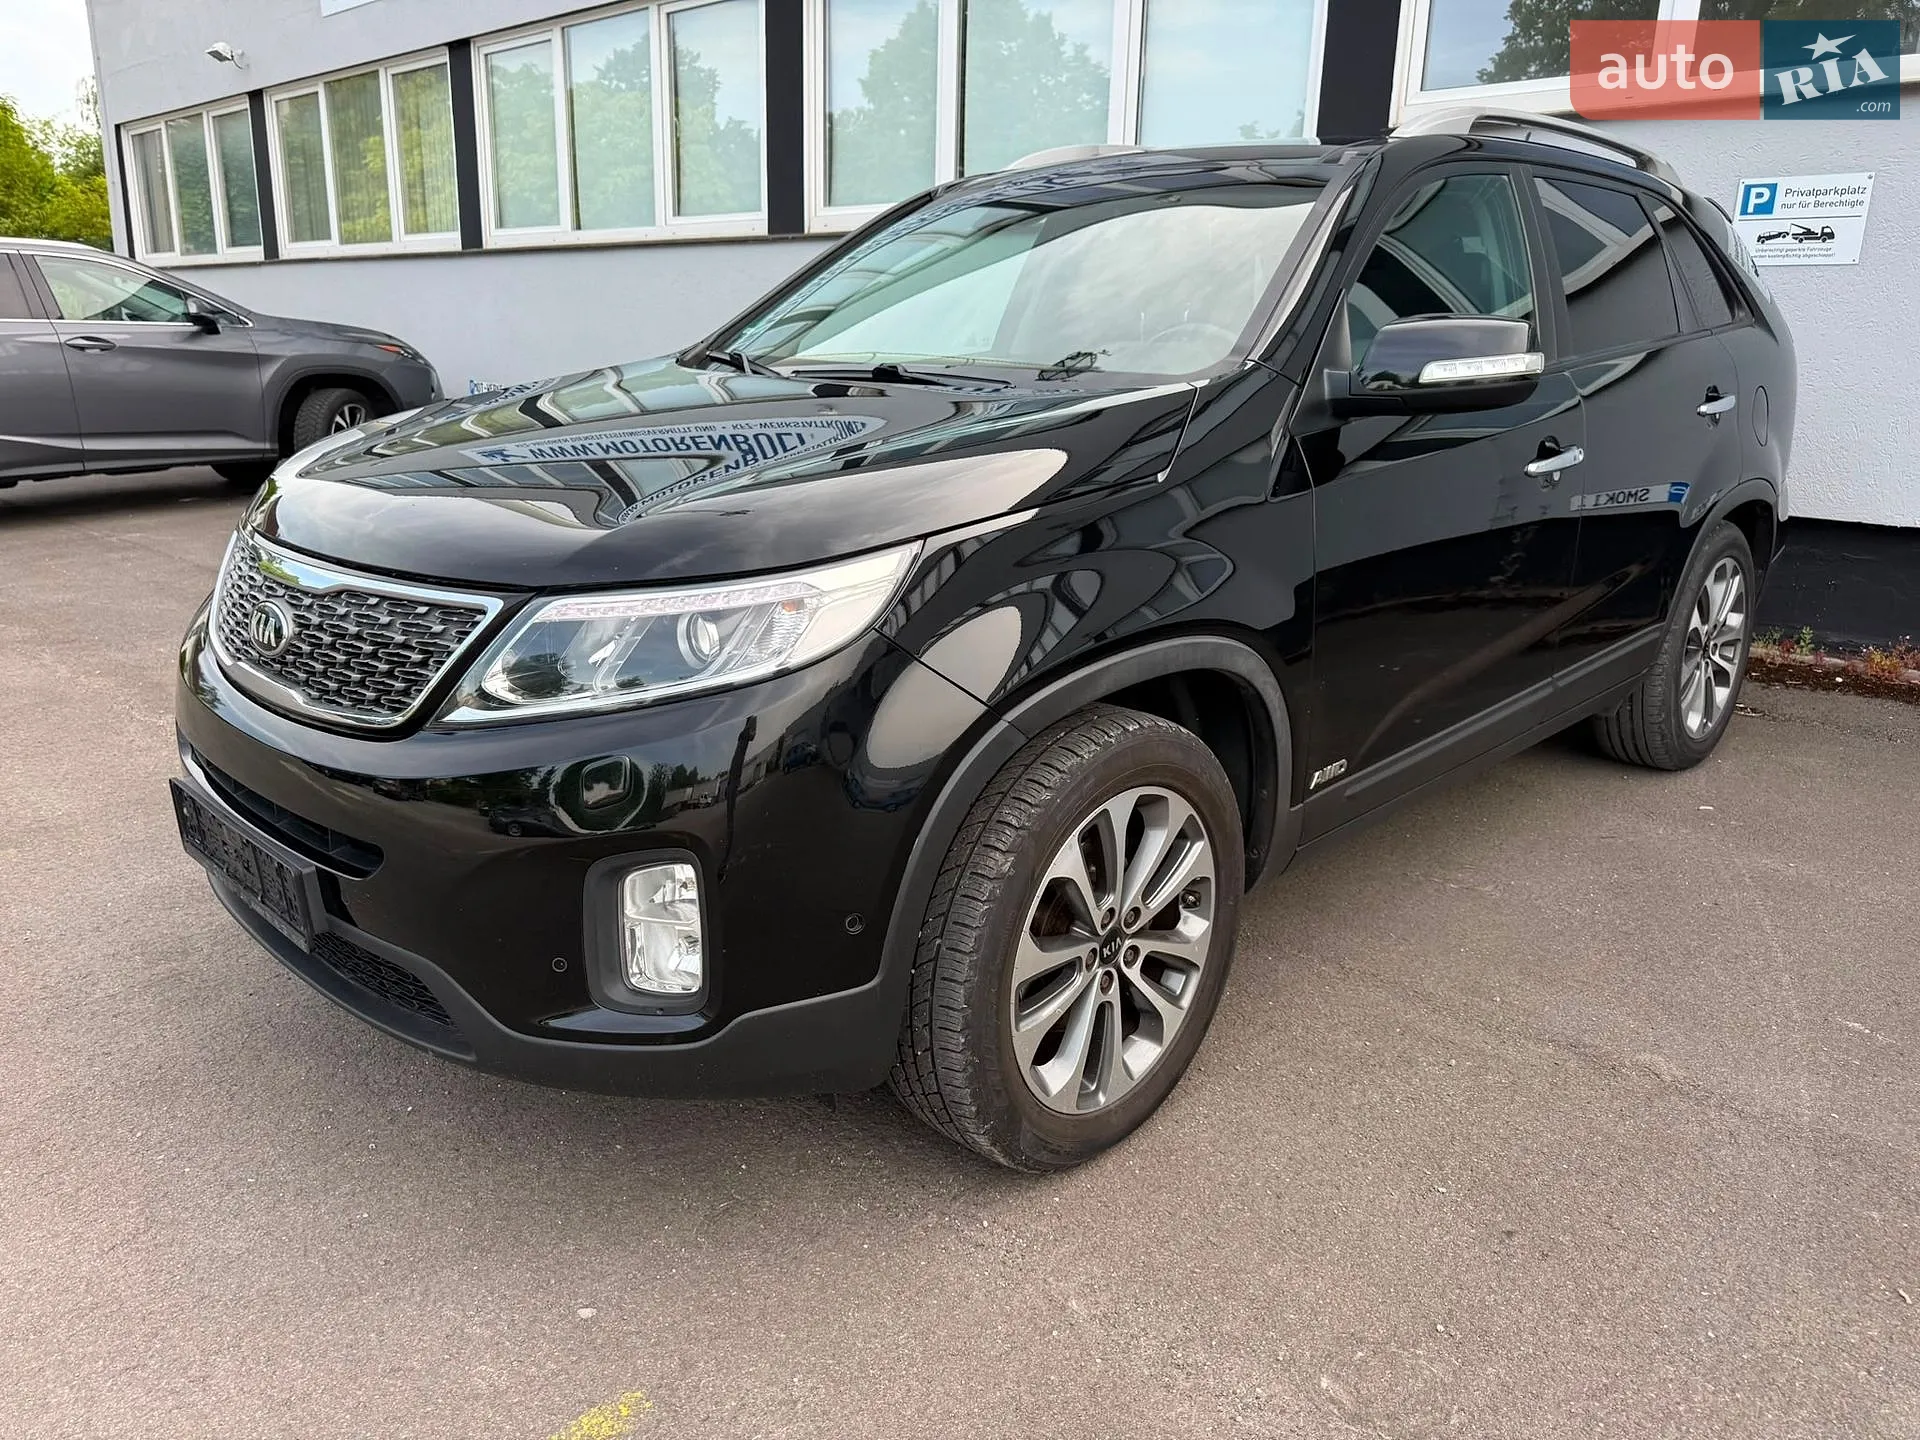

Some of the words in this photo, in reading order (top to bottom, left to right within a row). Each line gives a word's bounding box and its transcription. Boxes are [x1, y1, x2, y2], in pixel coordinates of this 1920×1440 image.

[1747, 187, 1770, 213] P
[1784, 186, 1867, 198] Privatparkplatz
[1798, 200, 1812, 209] für
[1813, 199, 1864, 209] Berechtigte
[1310, 759, 1347, 789] AWD
[1103, 937, 1121, 958] KIA
